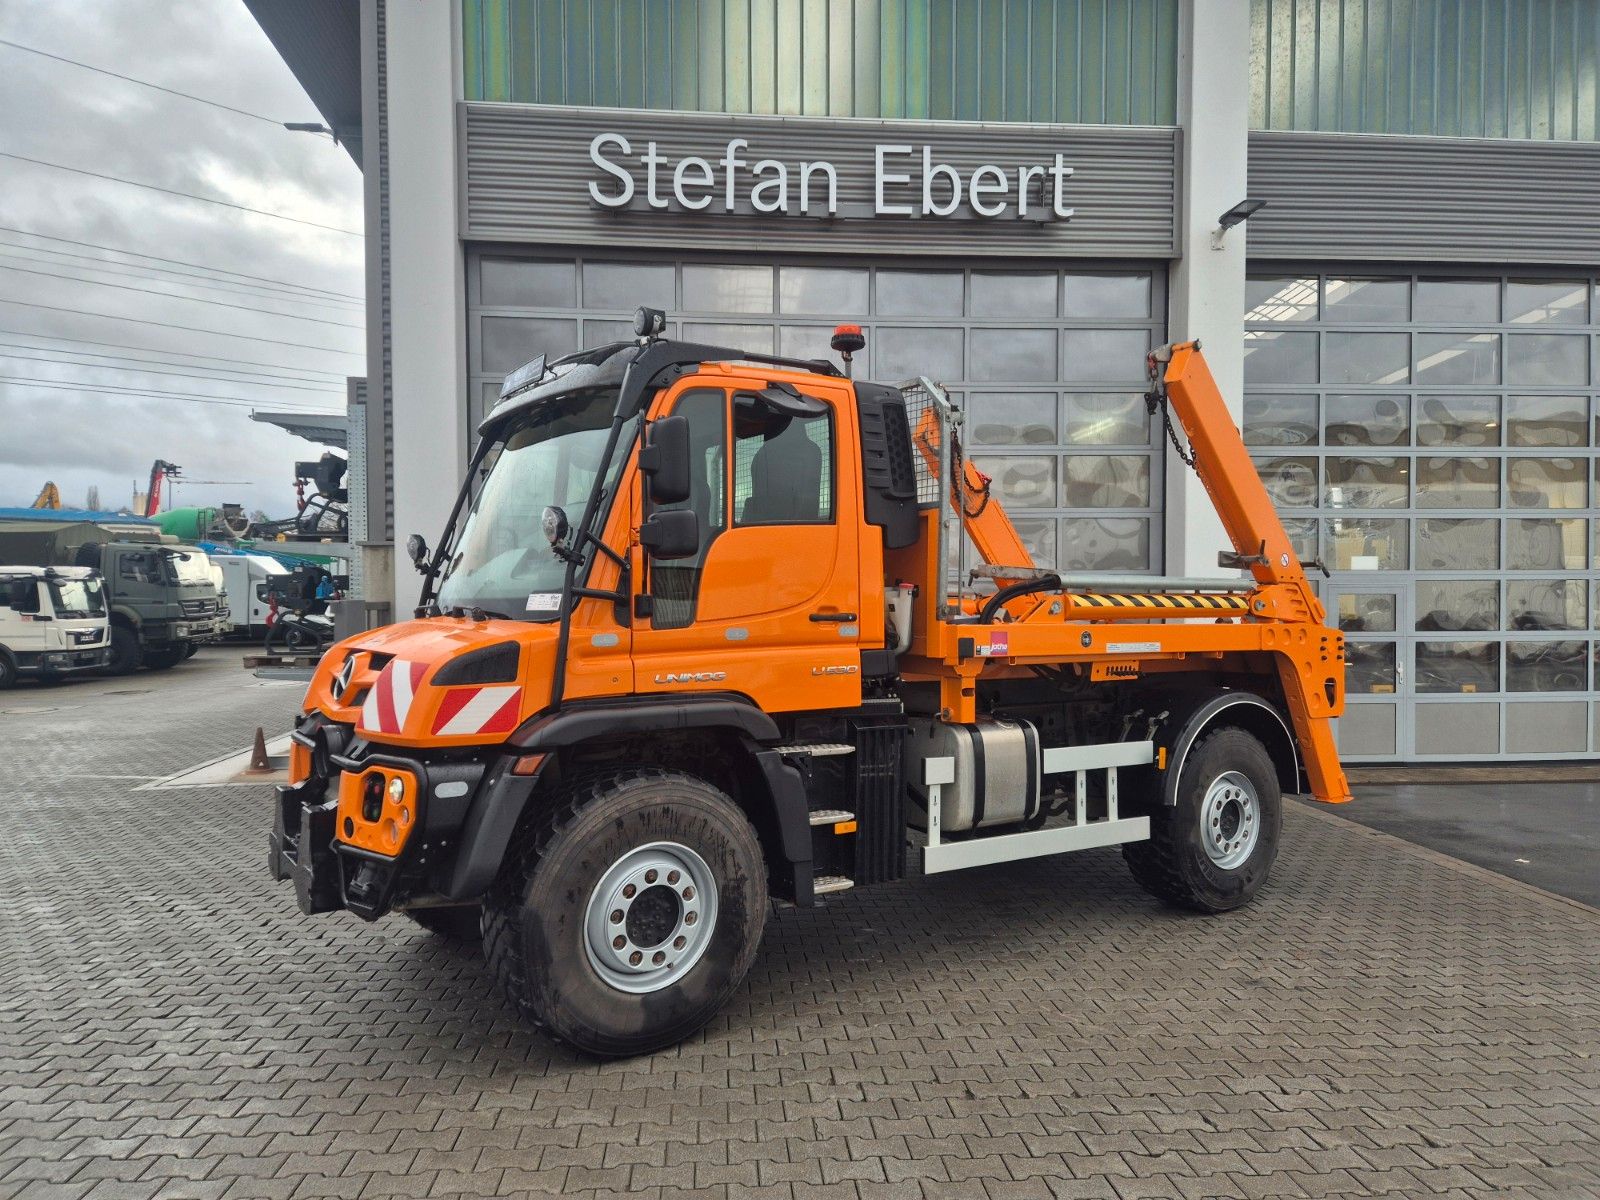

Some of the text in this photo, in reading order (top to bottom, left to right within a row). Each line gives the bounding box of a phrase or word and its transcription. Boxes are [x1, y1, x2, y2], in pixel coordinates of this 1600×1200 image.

[588, 133, 1075, 219] Stefan Ebert
[654, 671, 726, 684] UNIMOG
